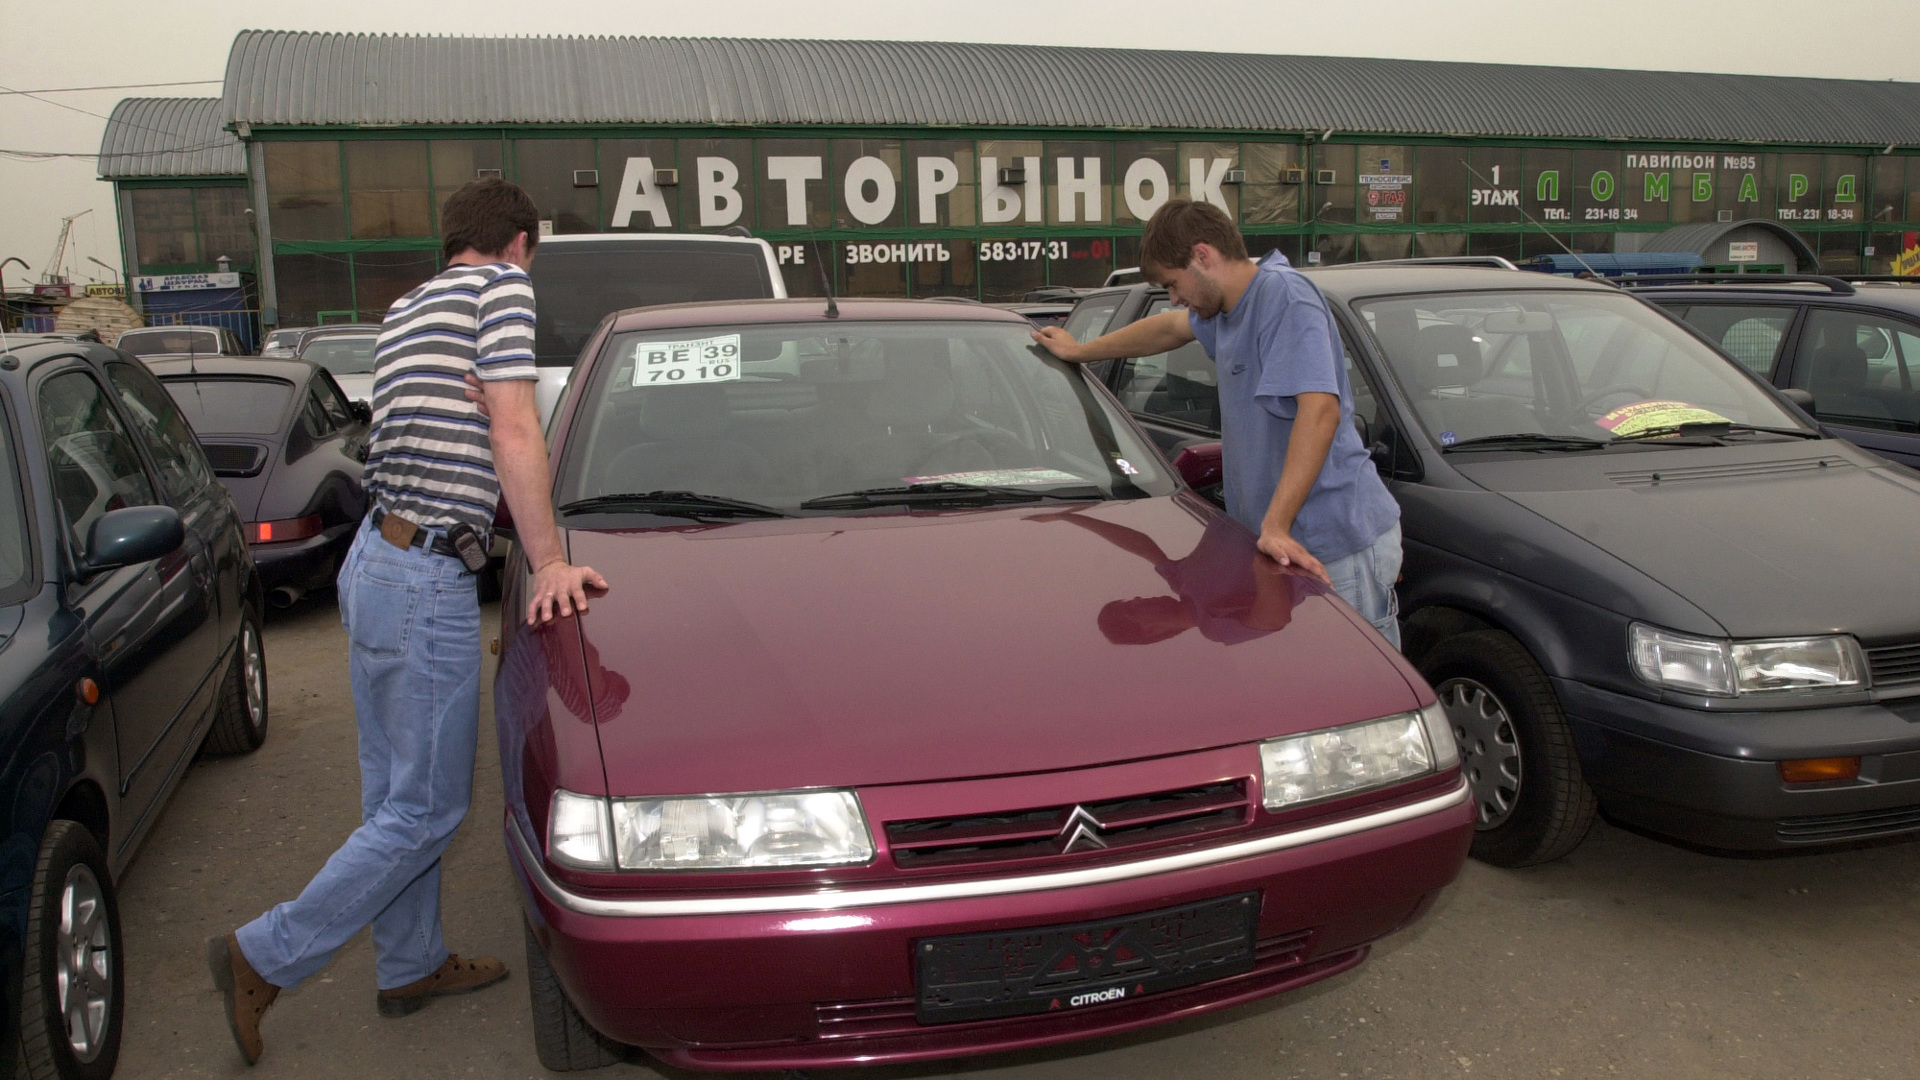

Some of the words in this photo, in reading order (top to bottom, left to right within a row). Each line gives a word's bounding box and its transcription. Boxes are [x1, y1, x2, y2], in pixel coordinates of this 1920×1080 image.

[1626, 155, 1715, 169] ПАВИЛЬОН
[1723, 156, 1756, 169] №85
[1491, 165, 1500, 186] 1
[611, 156, 1233, 227] АВТОРЫНОК
[1537, 170, 1857, 203] ЛОМБАРД
[1472, 189, 1520, 206] ЭТАЖ
[846, 243, 951, 264] ЗВОНИТЬ
[704, 344, 738, 359] 39
[1070, 987, 1126, 1006] CITROËN
